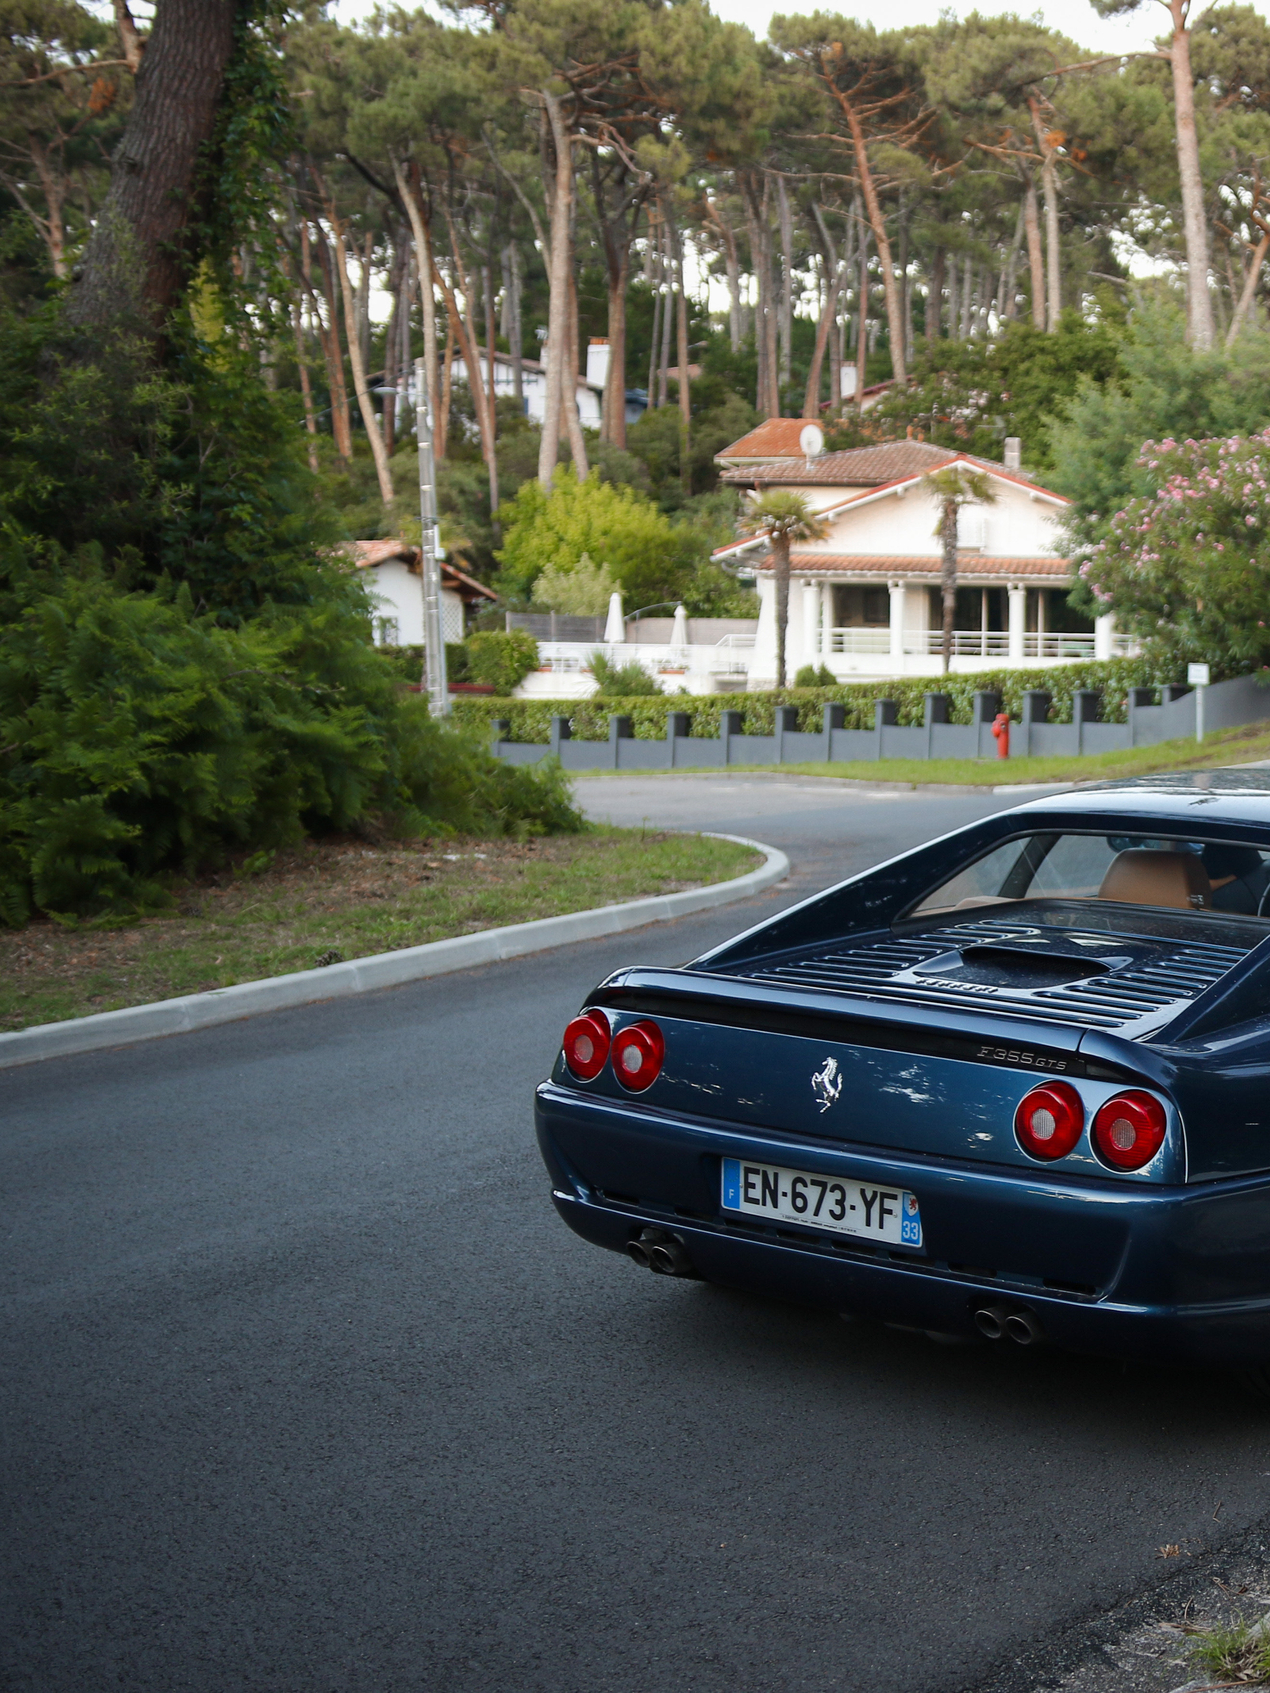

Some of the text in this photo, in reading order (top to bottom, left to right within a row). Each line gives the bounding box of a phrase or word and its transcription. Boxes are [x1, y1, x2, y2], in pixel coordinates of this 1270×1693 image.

[977, 1046, 1067, 1070] F355 GTS
[728, 1189, 734, 1200] F
[743, 1166, 898, 1229] EN-673-YF
[902, 1221, 918, 1240] 33
